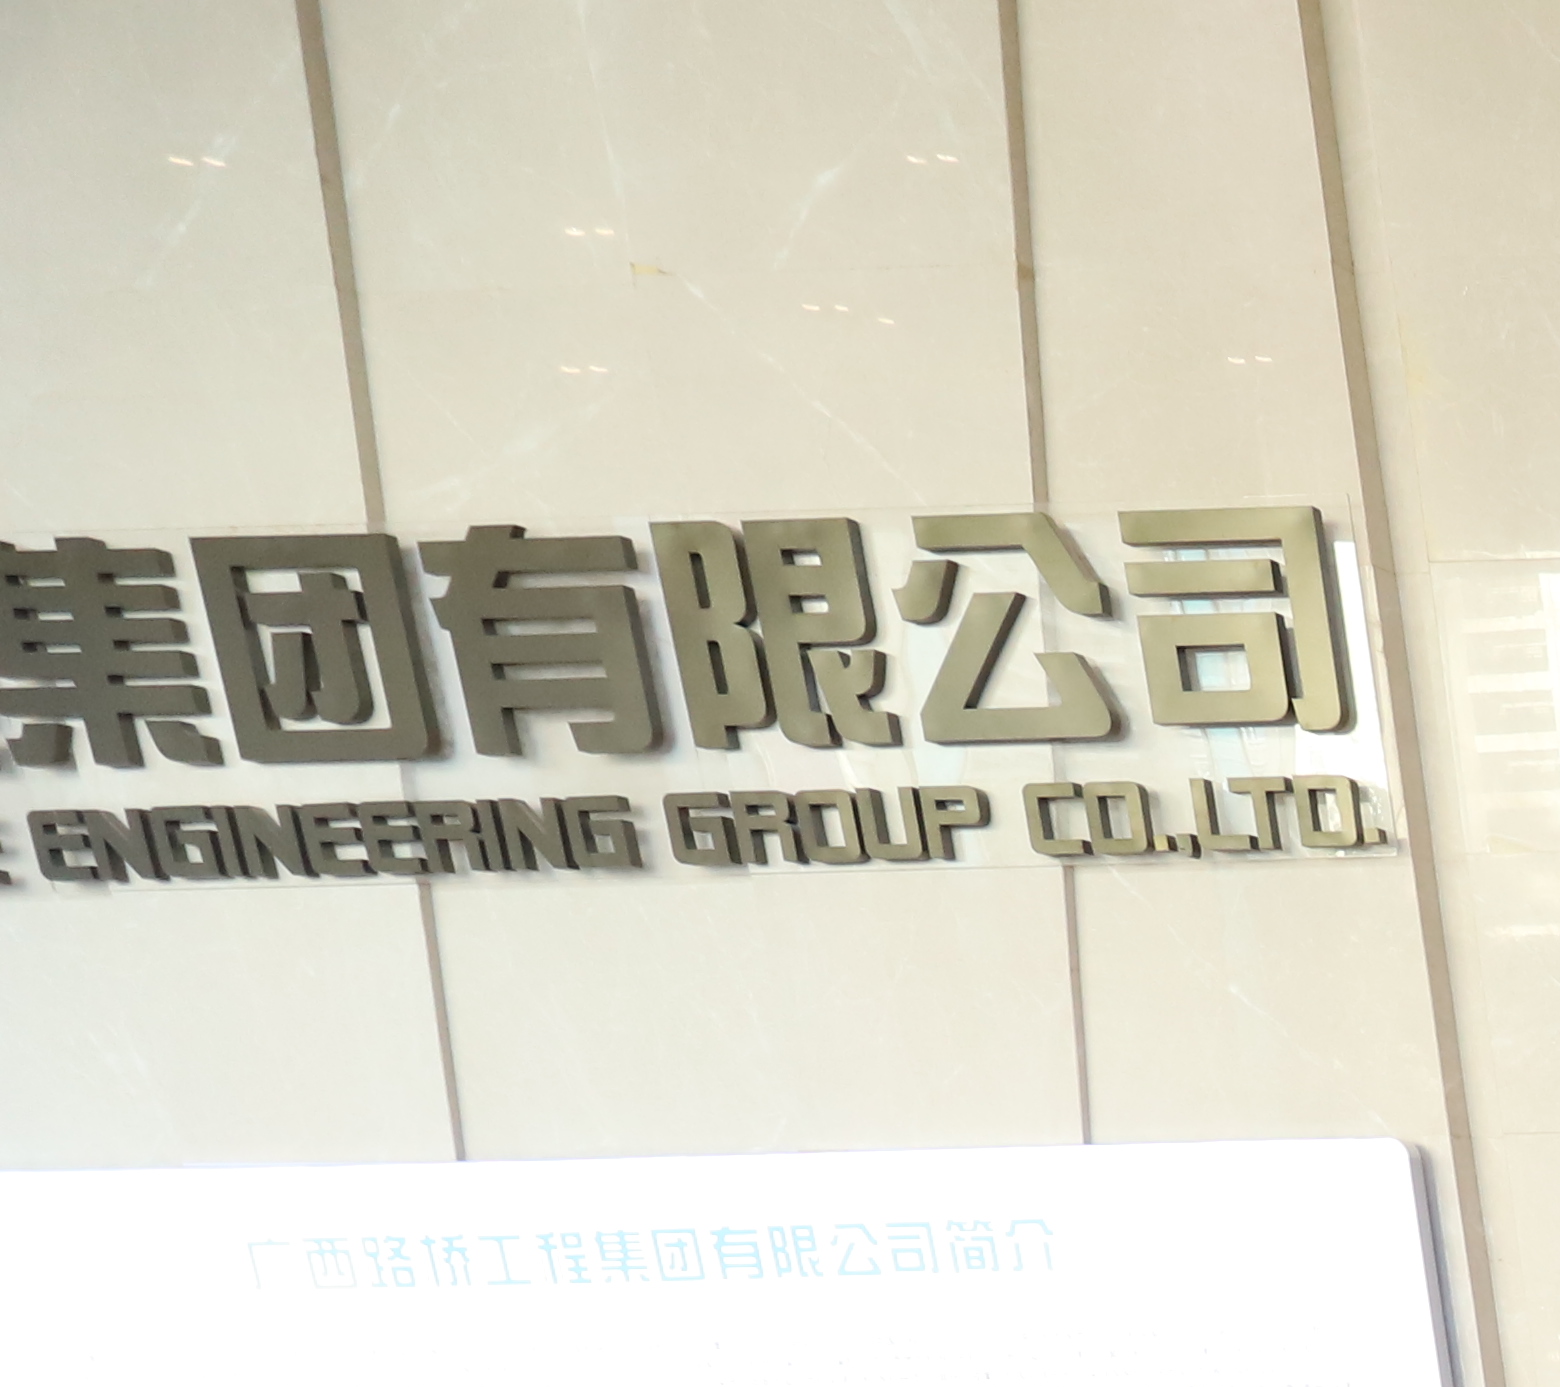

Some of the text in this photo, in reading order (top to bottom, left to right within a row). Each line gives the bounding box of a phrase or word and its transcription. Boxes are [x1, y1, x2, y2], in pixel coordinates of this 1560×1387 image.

[0, 506, 1355, 768] 集团有限公司
[27, 796, 643, 883] ENGINEERING
[663, 785, 991, 869] GROUP
[246, 1217, 1057, 1291] 广西路桥工程集团有限公司简介
